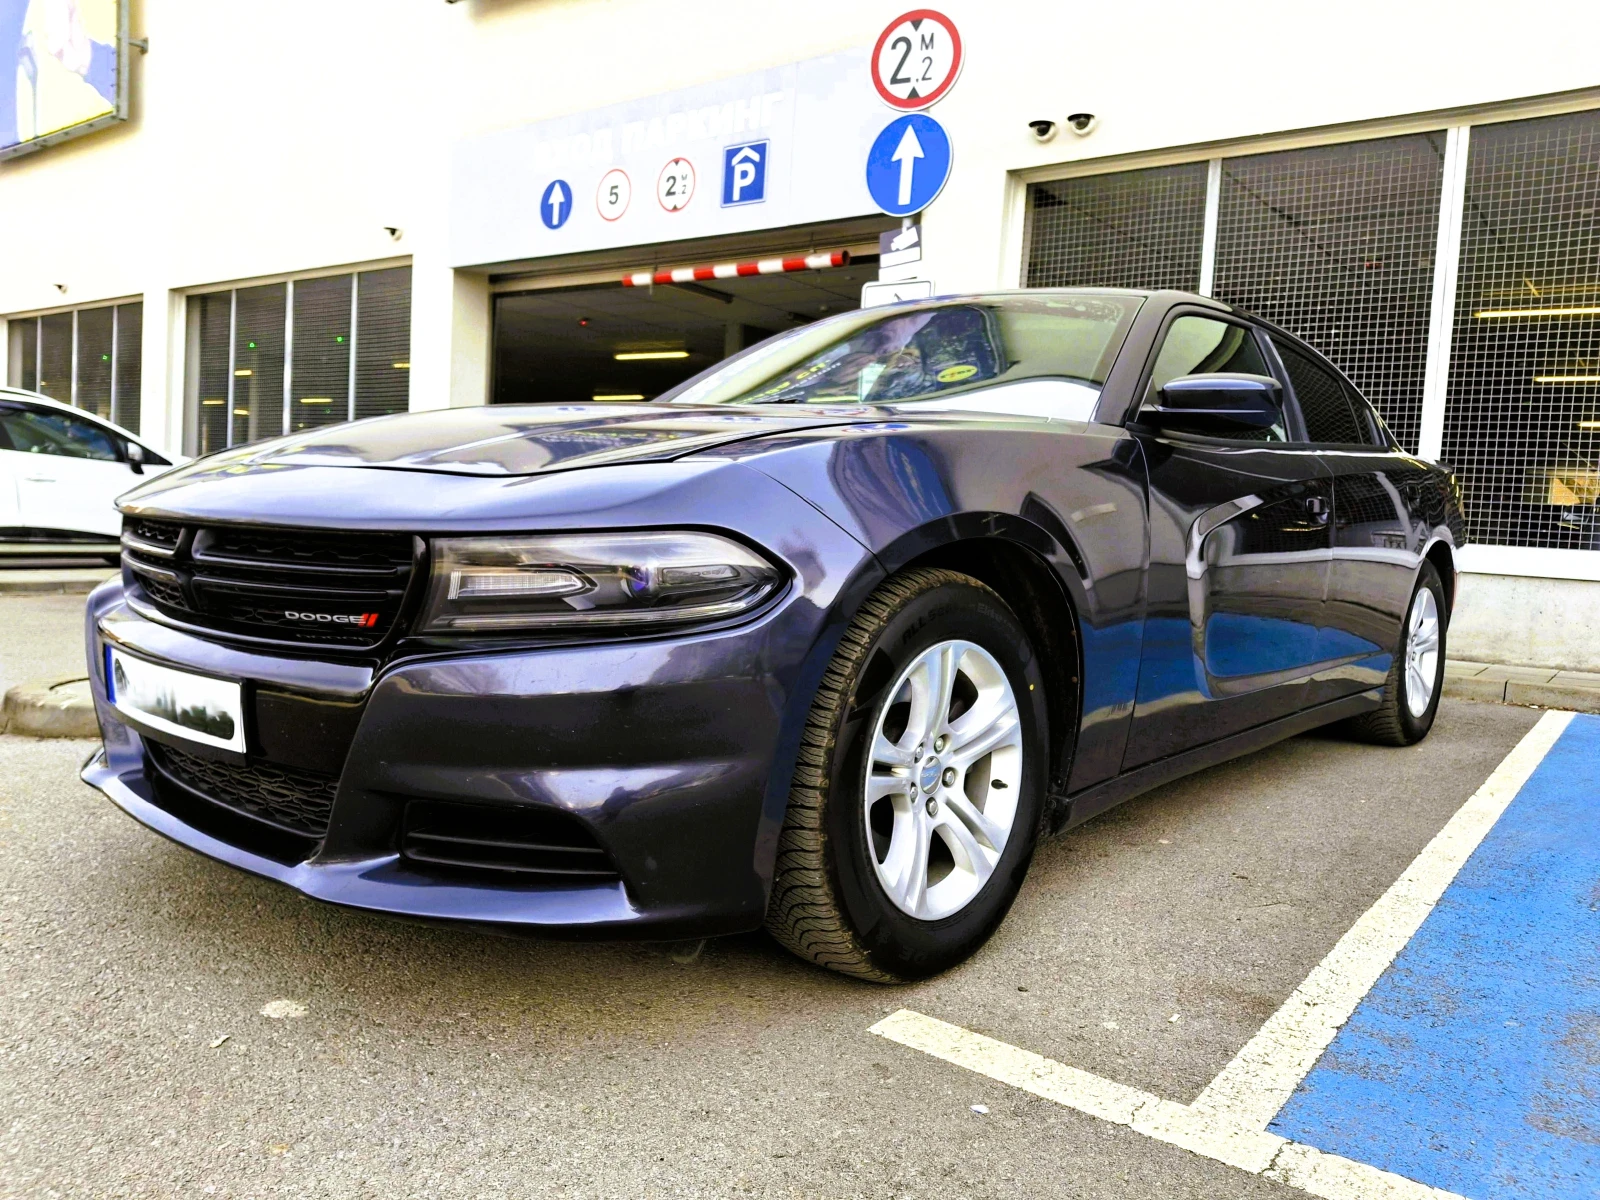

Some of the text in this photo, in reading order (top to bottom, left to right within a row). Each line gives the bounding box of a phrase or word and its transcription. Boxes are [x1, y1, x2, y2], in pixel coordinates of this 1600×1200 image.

[621, 91, 784, 154] ПАРКИНГ
[608, 185, 619, 205] 5
[732, 161, 756, 202] P
[284, 611, 366, 624] DODGE
